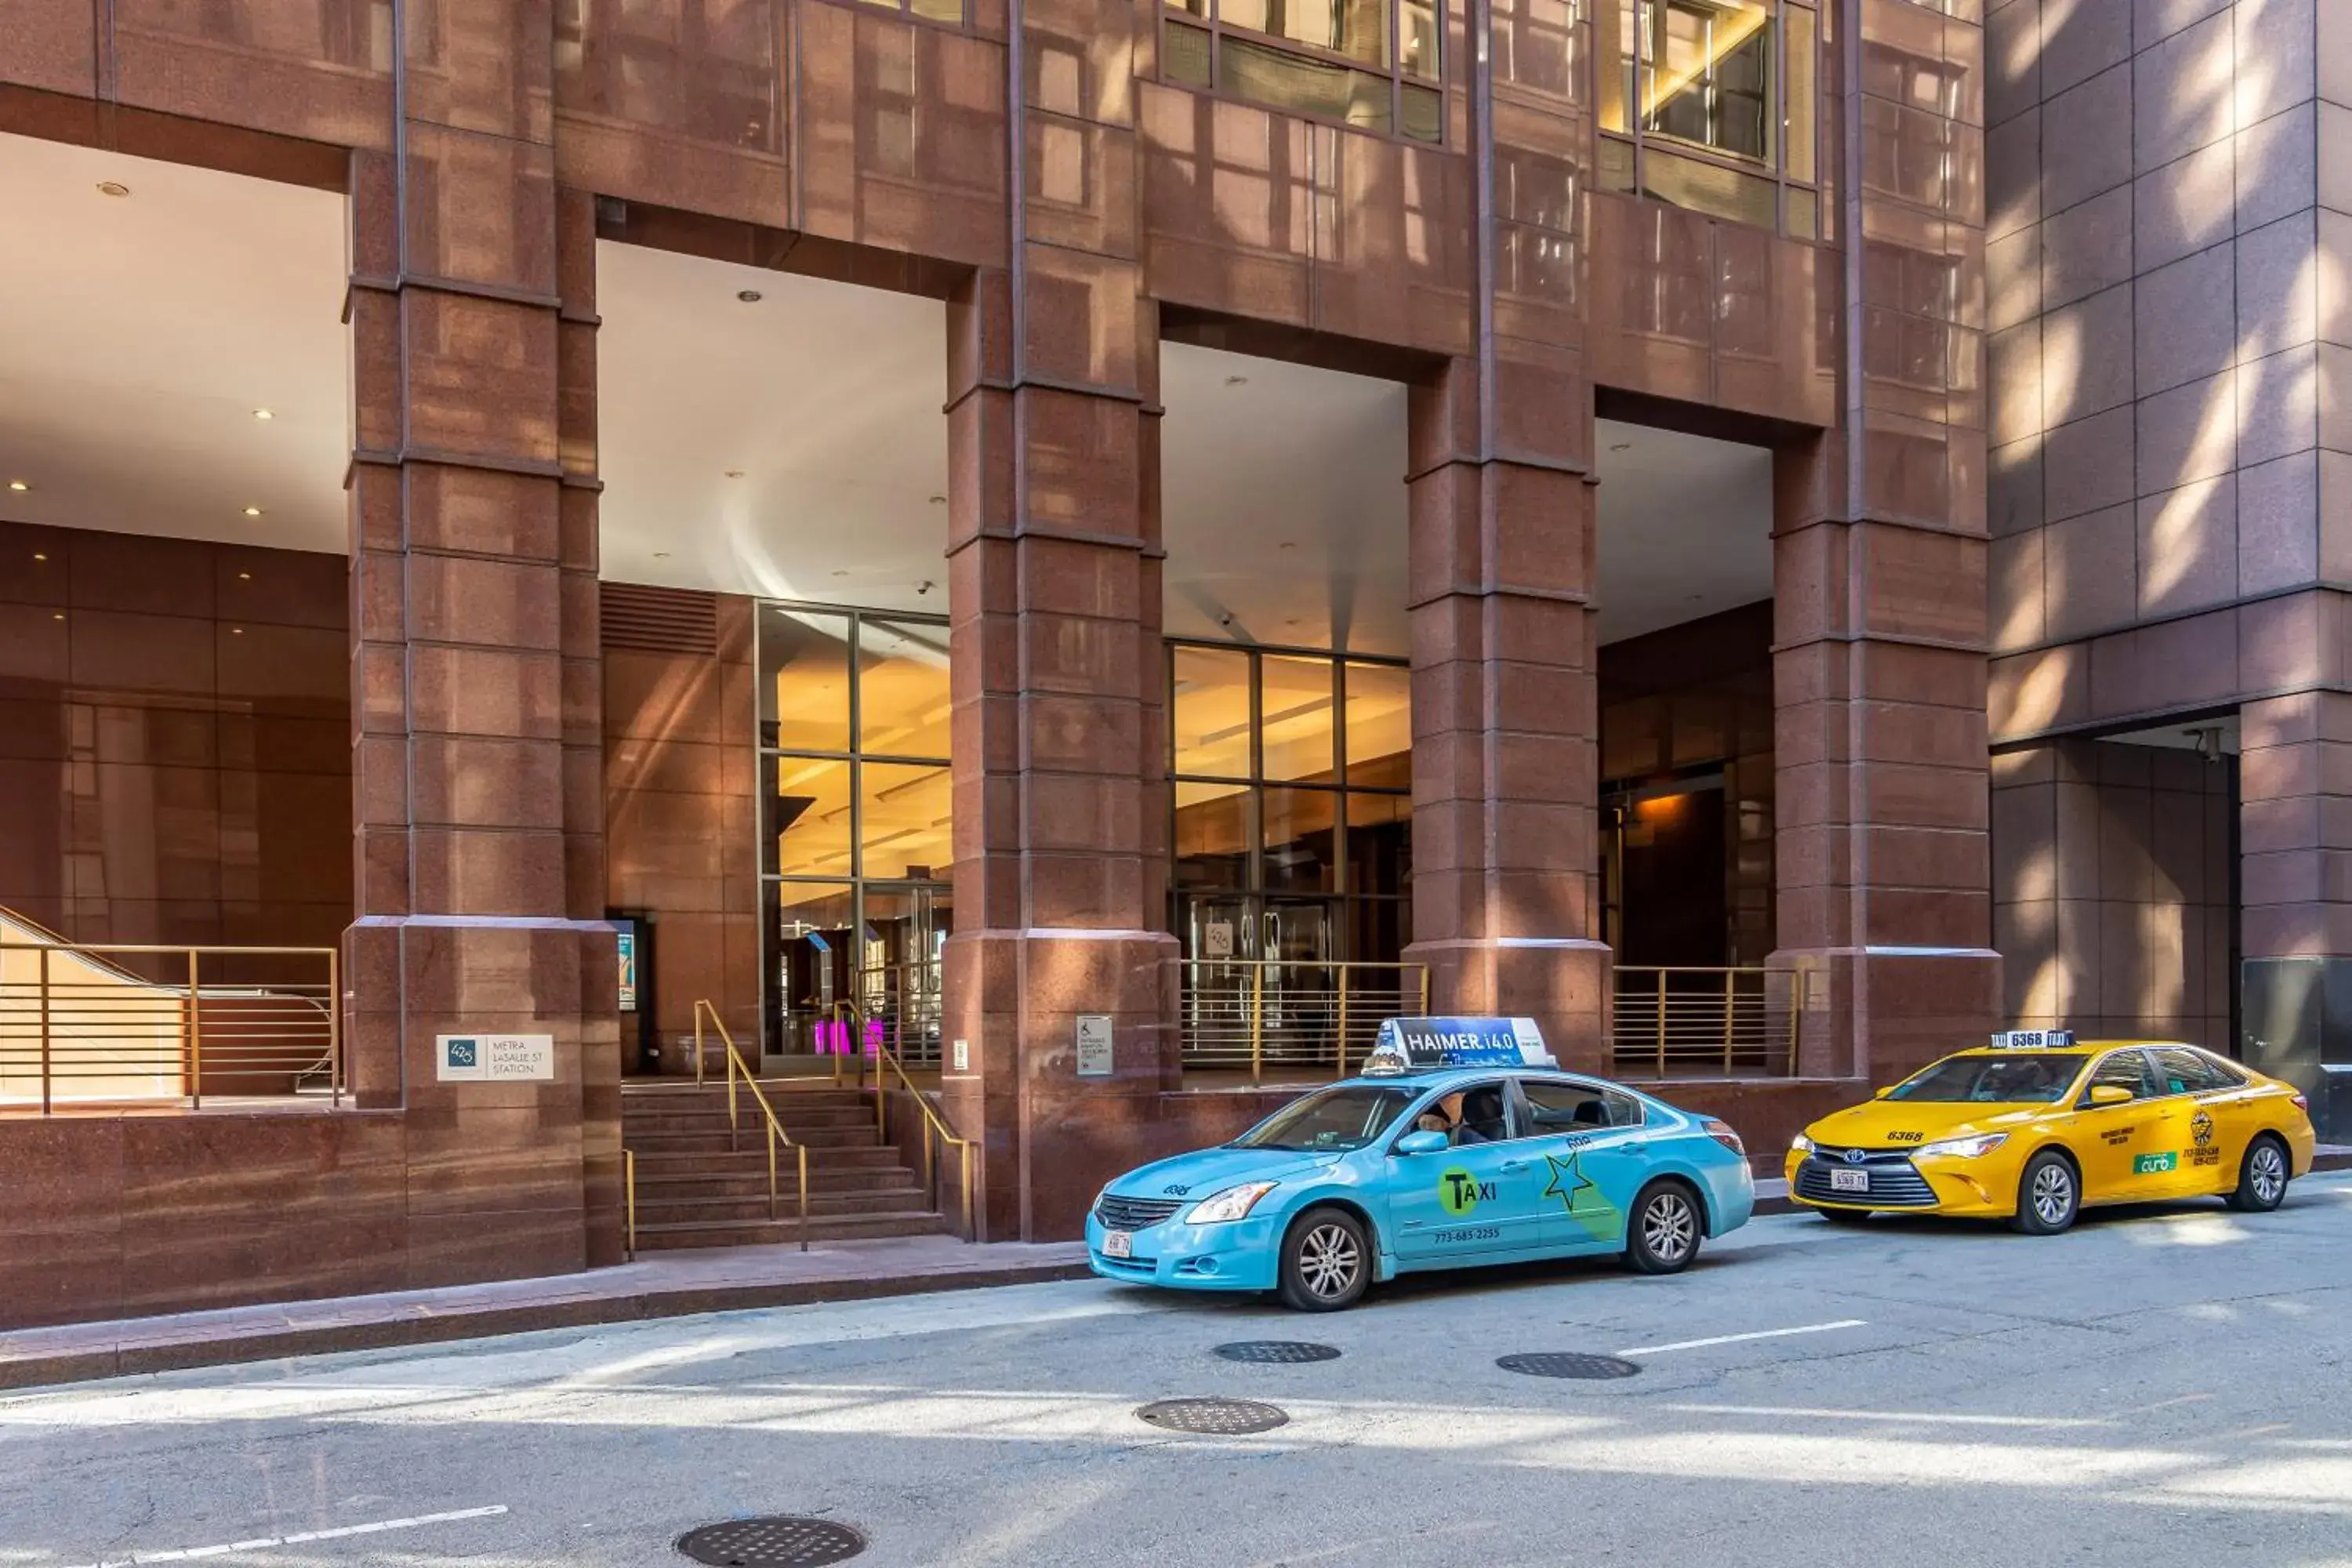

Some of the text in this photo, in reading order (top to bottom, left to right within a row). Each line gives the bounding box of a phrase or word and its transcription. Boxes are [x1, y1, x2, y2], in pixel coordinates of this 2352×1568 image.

[493, 1040, 526, 1051] METRA
[2012, 1033, 2042, 1047] 6368
[493, 1064, 535, 1073] STATION
[1887, 1131, 1923, 1142] 6368
[1445, 1173, 1497, 1210] TAXI
